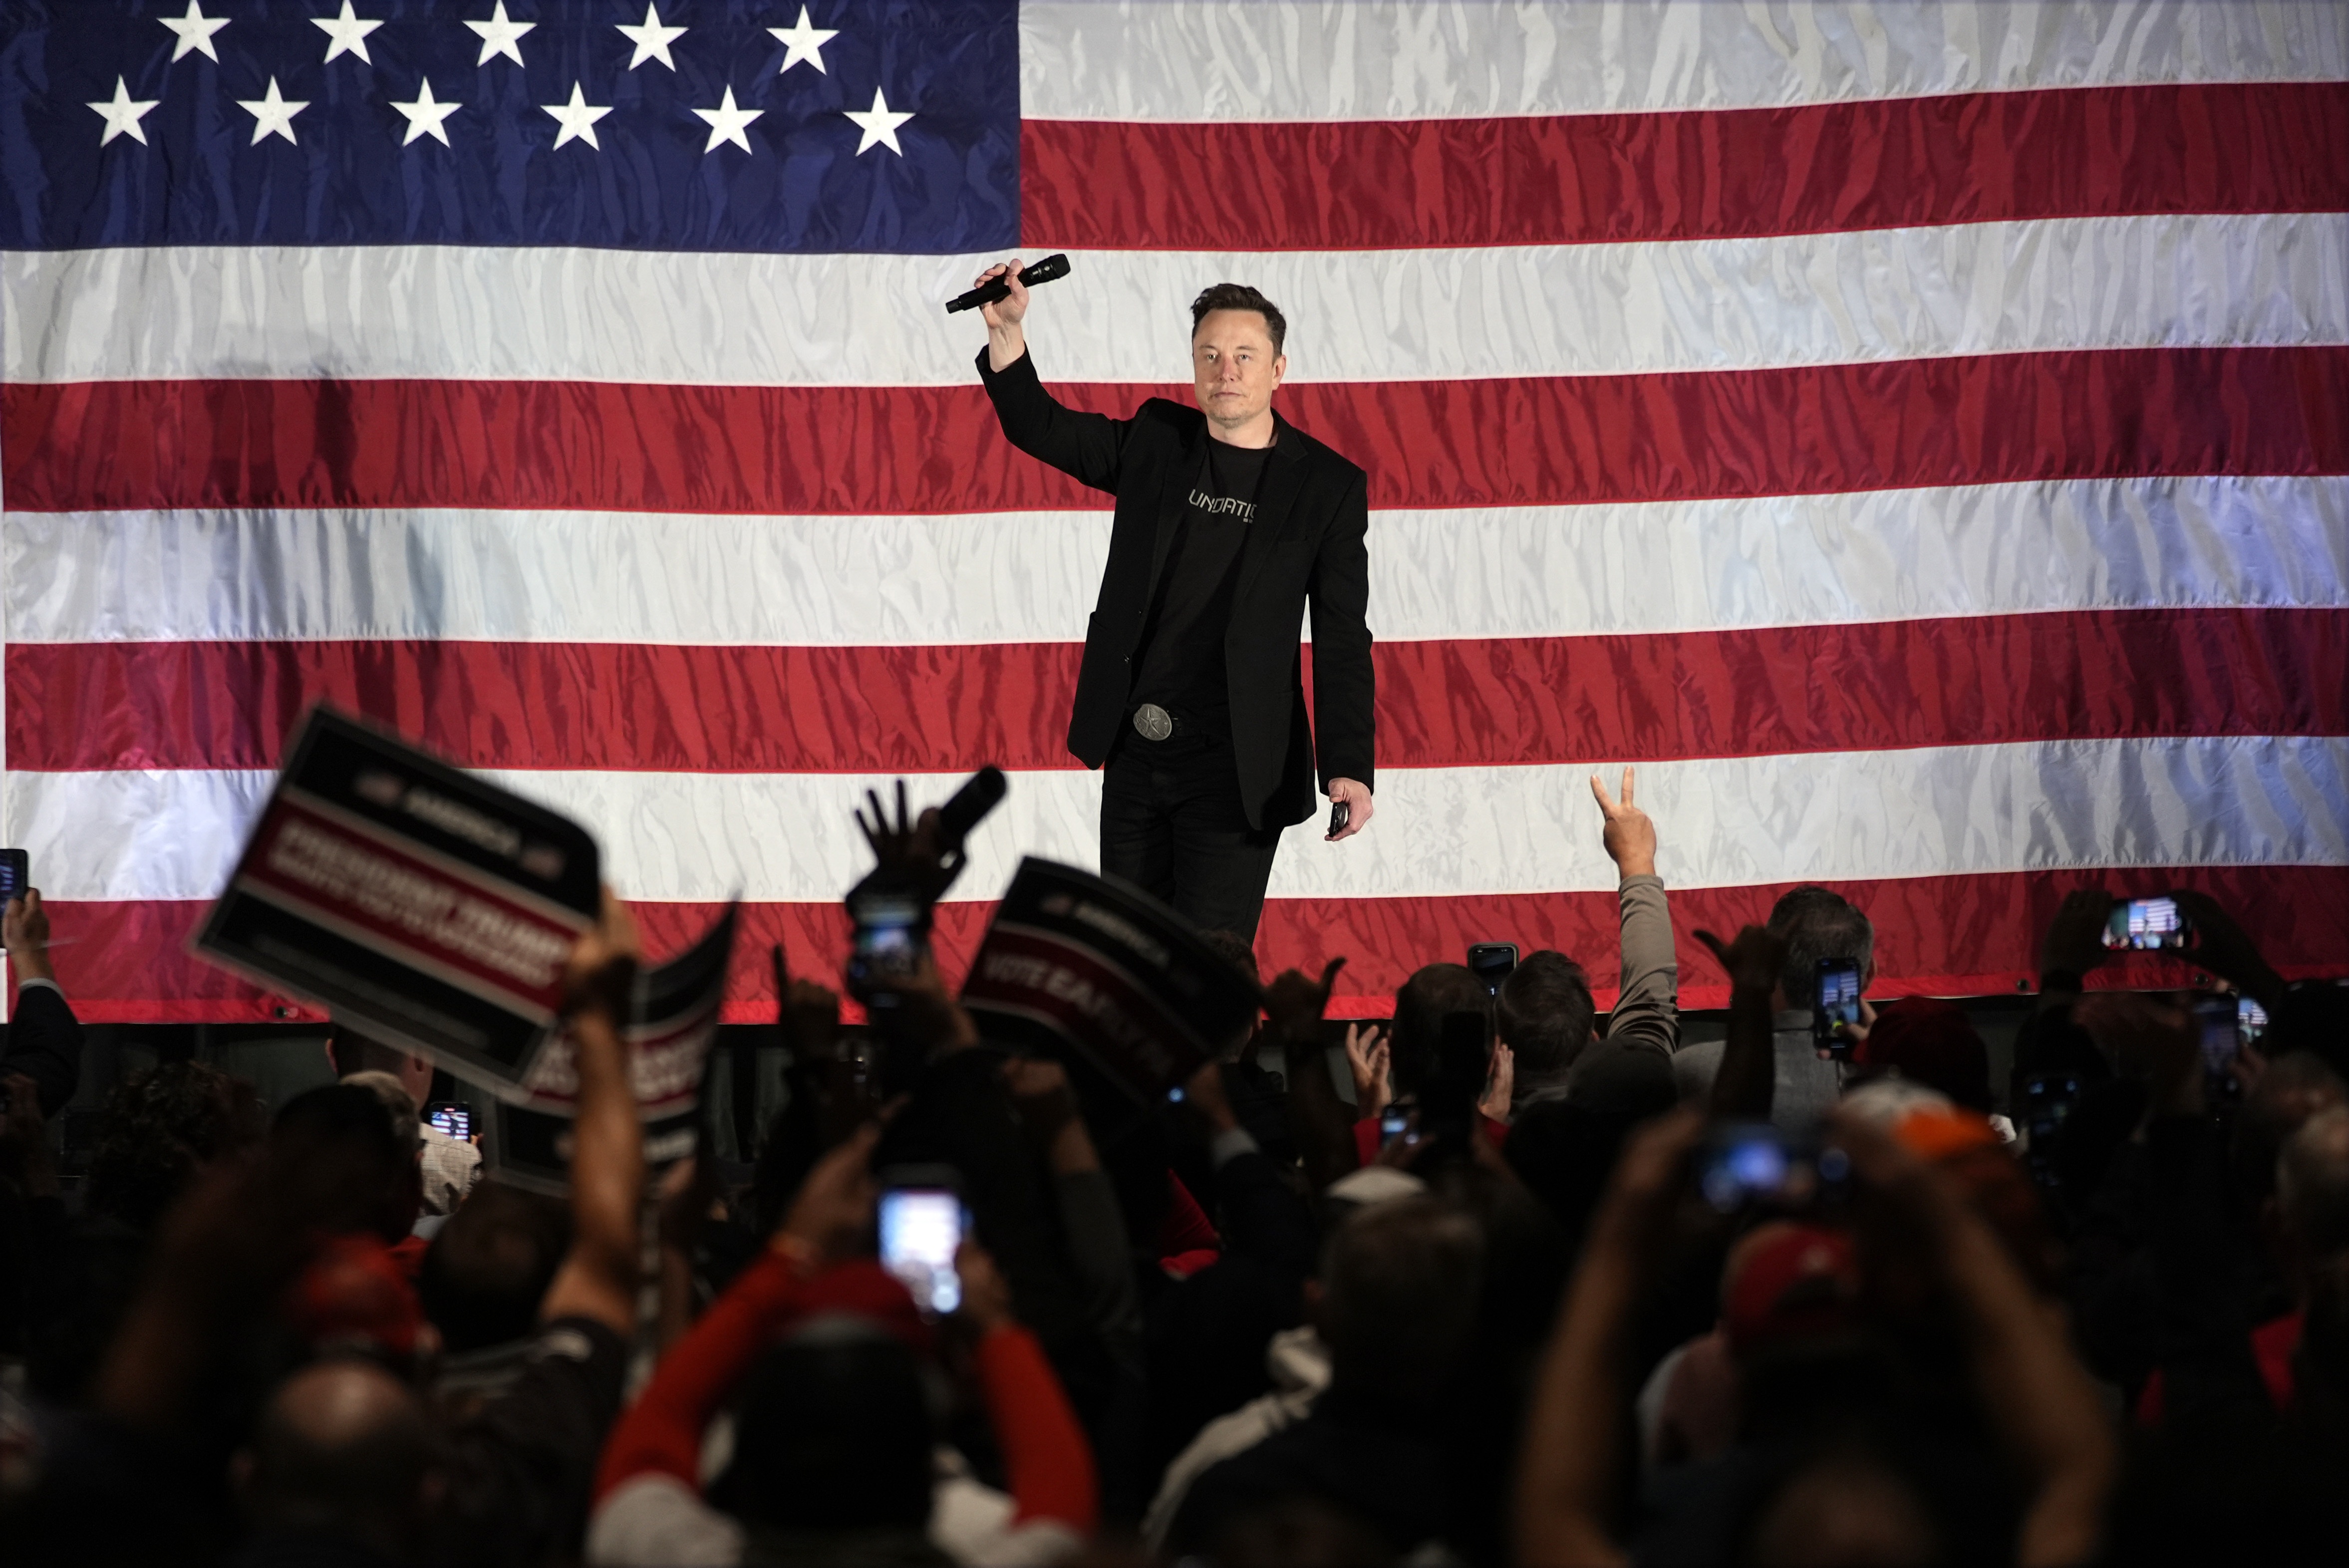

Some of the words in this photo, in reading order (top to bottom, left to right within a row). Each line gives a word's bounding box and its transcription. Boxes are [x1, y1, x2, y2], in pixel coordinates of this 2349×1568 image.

[278, 820, 456, 917] PRESIDENT
[453, 897, 569, 968] TRUMP
[986, 952, 1051, 990] VOTE
